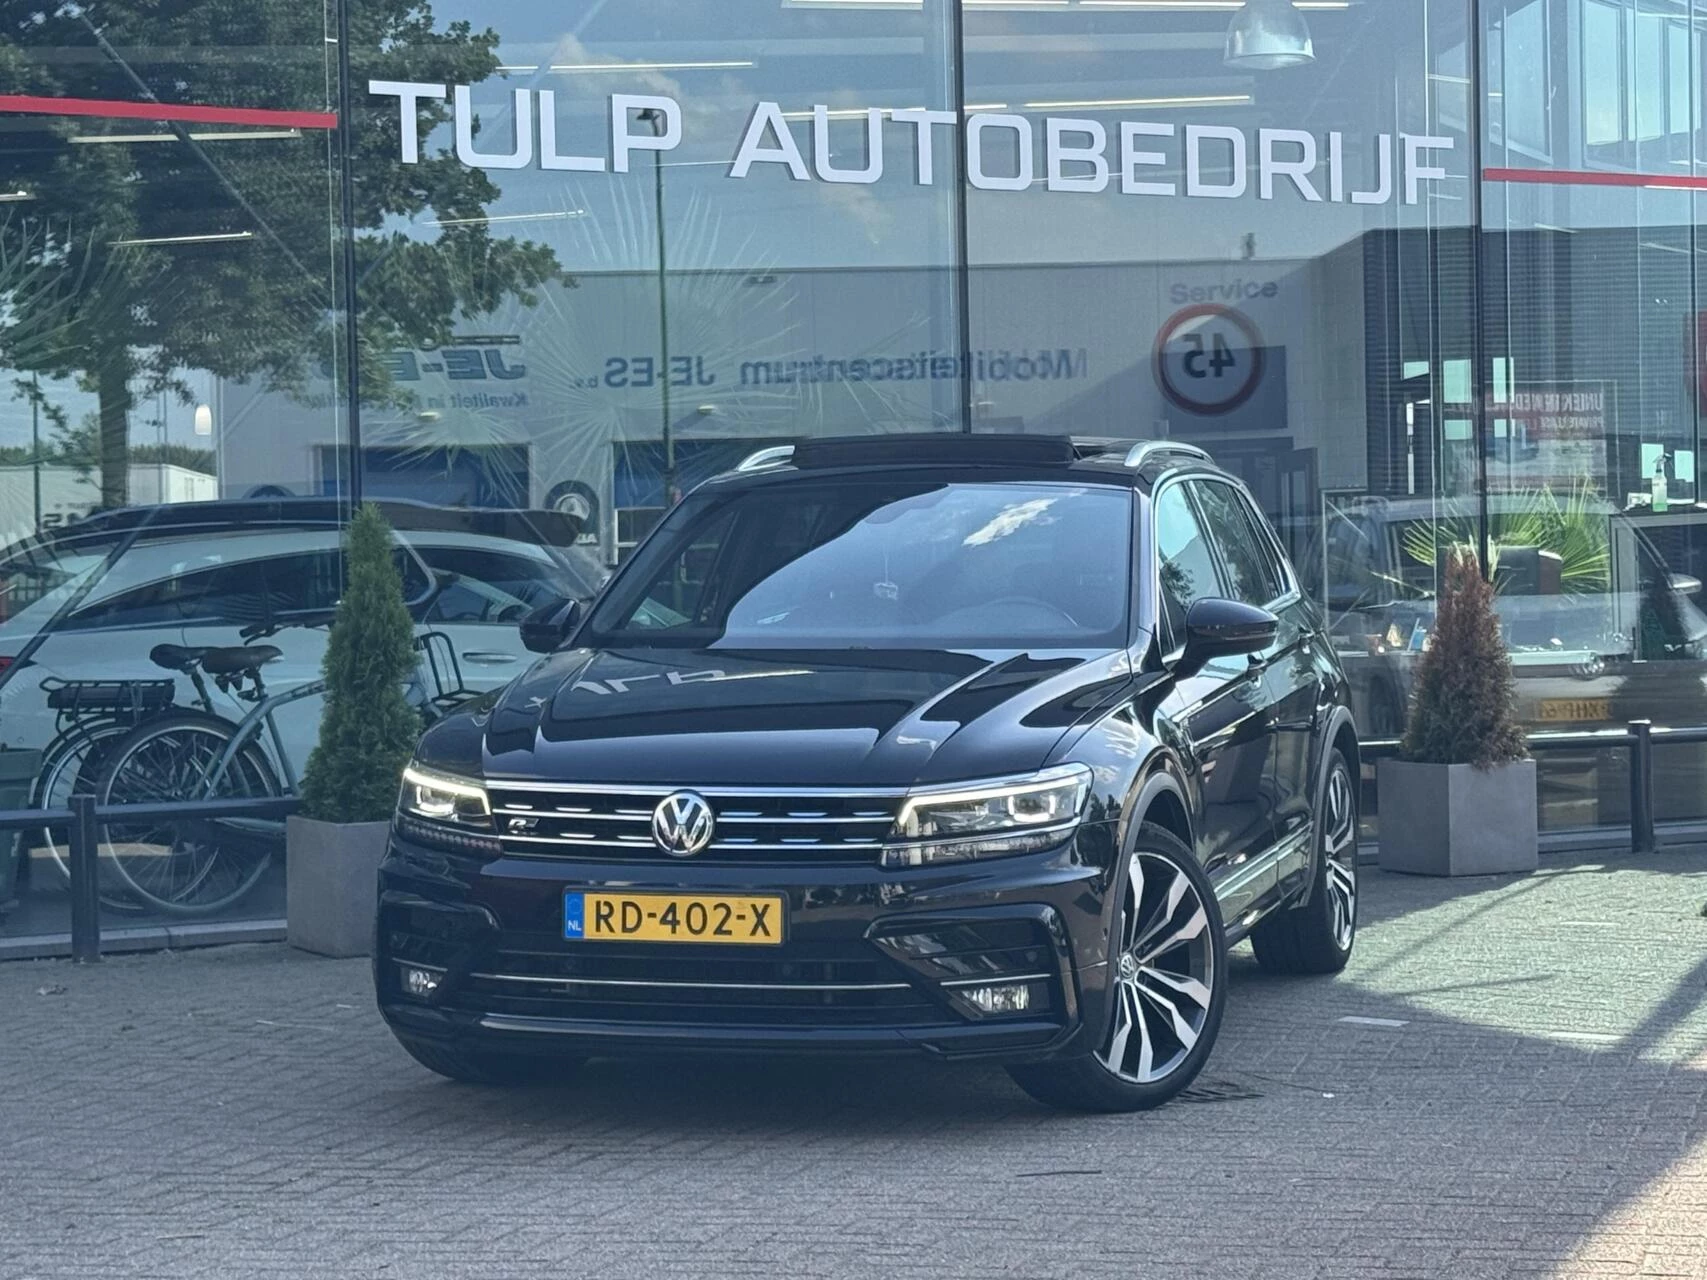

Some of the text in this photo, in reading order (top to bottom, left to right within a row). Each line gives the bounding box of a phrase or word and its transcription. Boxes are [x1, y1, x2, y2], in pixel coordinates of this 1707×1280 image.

[368, 79, 1454, 206] TULP AUTOBEDRIJF
[1170, 278, 1278, 304] Service
[567, 919, 582, 932] NL
[594, 900, 771, 937] RD-402-X
